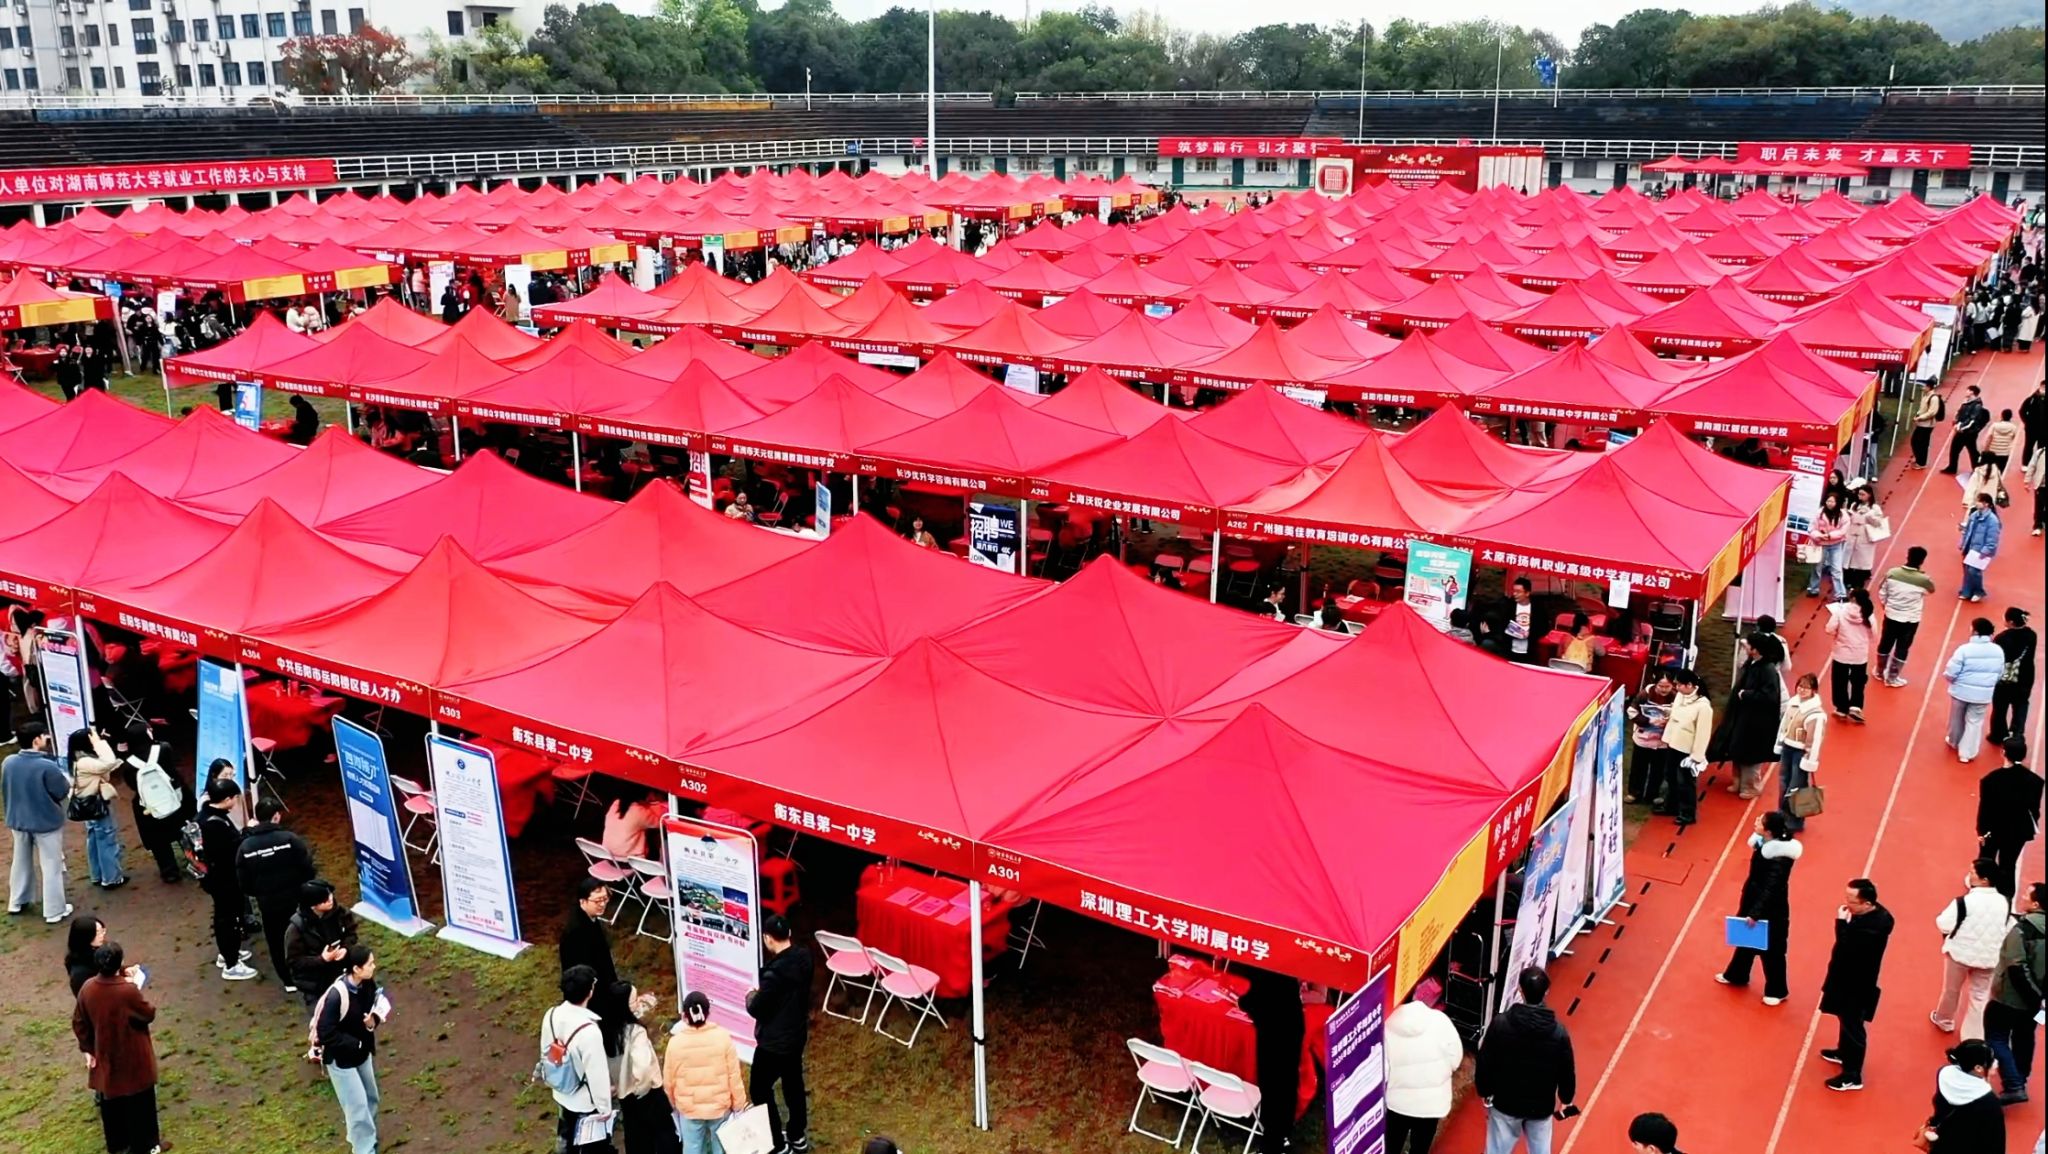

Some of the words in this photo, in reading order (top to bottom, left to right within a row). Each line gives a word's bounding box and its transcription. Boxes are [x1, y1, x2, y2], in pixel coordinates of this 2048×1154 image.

[1177, 140, 1245, 154] 筑梦前行
[1760, 146, 1843, 162] 职启未来
[1859, 148, 1947, 164] 才赢天下
[1030, 487, 1050, 497] A263
[970, 514, 999, 541] 招聘
[1000, 519, 1014, 530] WE
[1226, 520, 1249, 530] A262
[1481, 549, 1671, 590] 太原市扬帆职业高级中学有限公司
[79, 601, 96, 613] A305
[241, 648, 262, 661] A304
[276, 656, 402, 704] 中共岳阳市岳阳楼区委人才办
[439, 705, 462, 720] A303
[512, 725, 594, 765] 衡东县第二中学
[680, 778, 708, 795] A302
[774, 802, 877, 847] 衡东县第一中学
[987, 863, 1021, 883] A301
[1080, 889, 1272, 962] 深圳理工大学附属中学
